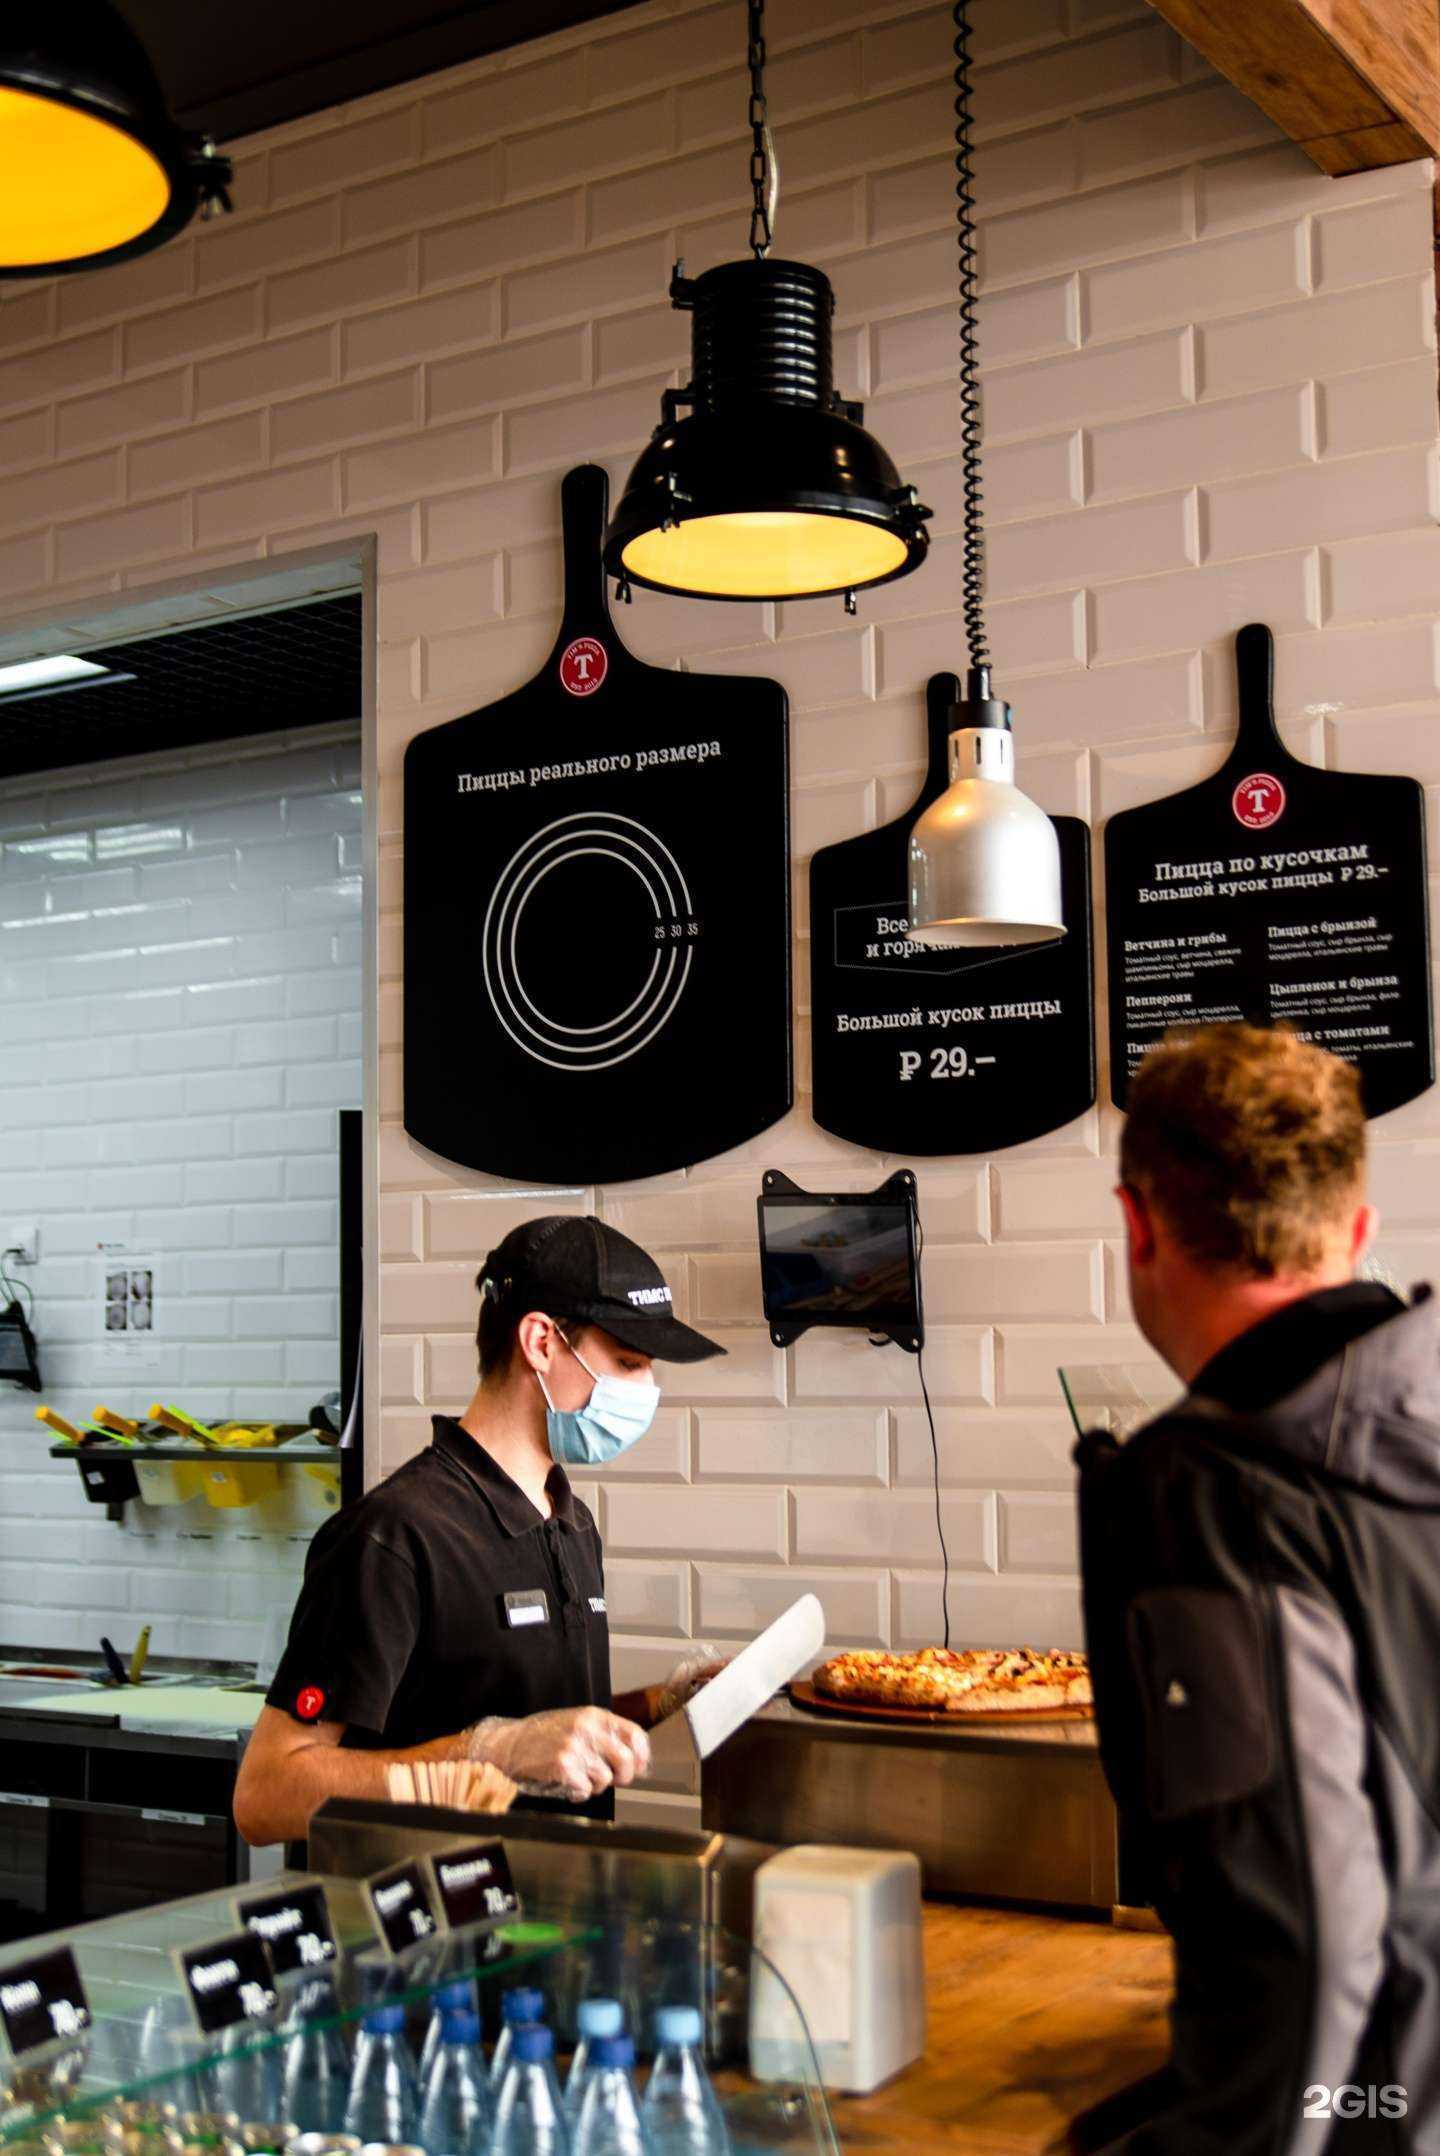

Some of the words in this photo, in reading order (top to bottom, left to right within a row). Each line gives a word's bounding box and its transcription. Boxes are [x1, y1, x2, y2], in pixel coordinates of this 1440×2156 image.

[458, 769, 525, 792] Пиццы
[530, 754, 631, 786] реального
[636, 740, 721, 771] размера
[1155, 859, 1224, 881] Пицца
[1229, 856, 1255, 874] по
[1259, 844, 1369, 872] кусочкам
[1138, 882, 1214, 903] Большой
[1218, 877, 1268, 898] кусок
[1271, 871, 1333, 889] пиццы
[655, 926, 666, 939] 25
[671, 924, 682, 938] 30
[687, 922, 698, 936] 35
[1268, 926, 1310, 938] Пицца
[1320, 916, 1377, 935] брынзой
[866, 944, 880, 958] и
[1124, 938, 1175, 952] Ветчина
[1188, 931, 1227, 948] грибы
[1269, 981, 1336, 996] Цыпленок
[1349, 975, 1399, 991] брынза
[837, 1007, 923, 1032] Большой
[928, 1004, 985, 1028] кусок
[989, 999, 1062, 1021] пиццы
[1324, 1025, 1390, 1040] томатами
